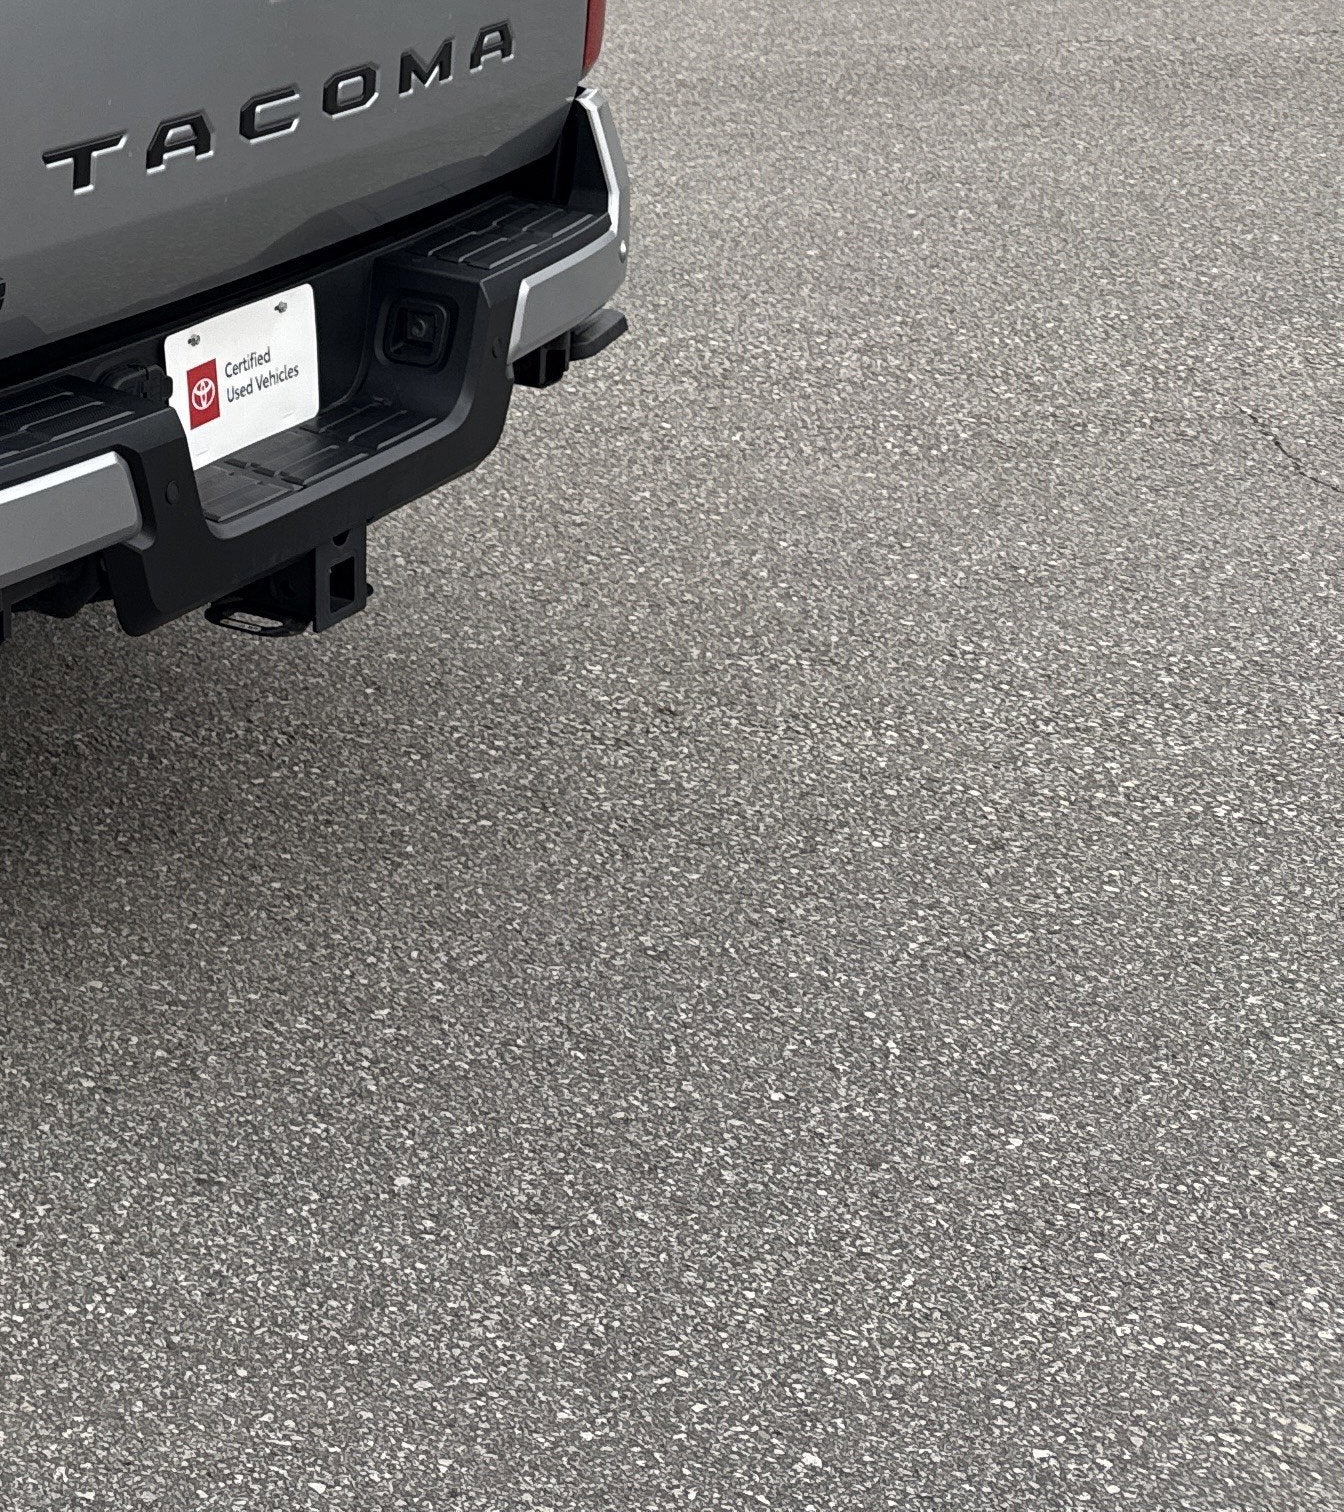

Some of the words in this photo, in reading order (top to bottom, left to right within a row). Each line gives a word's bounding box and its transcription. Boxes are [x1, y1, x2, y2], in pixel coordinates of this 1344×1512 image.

[42, 19, 514, 195] TACOMA
[224, 346, 271, 378] Certified
[226, 377, 254, 403] Used
[255, 364, 300, 391] Vehicles
